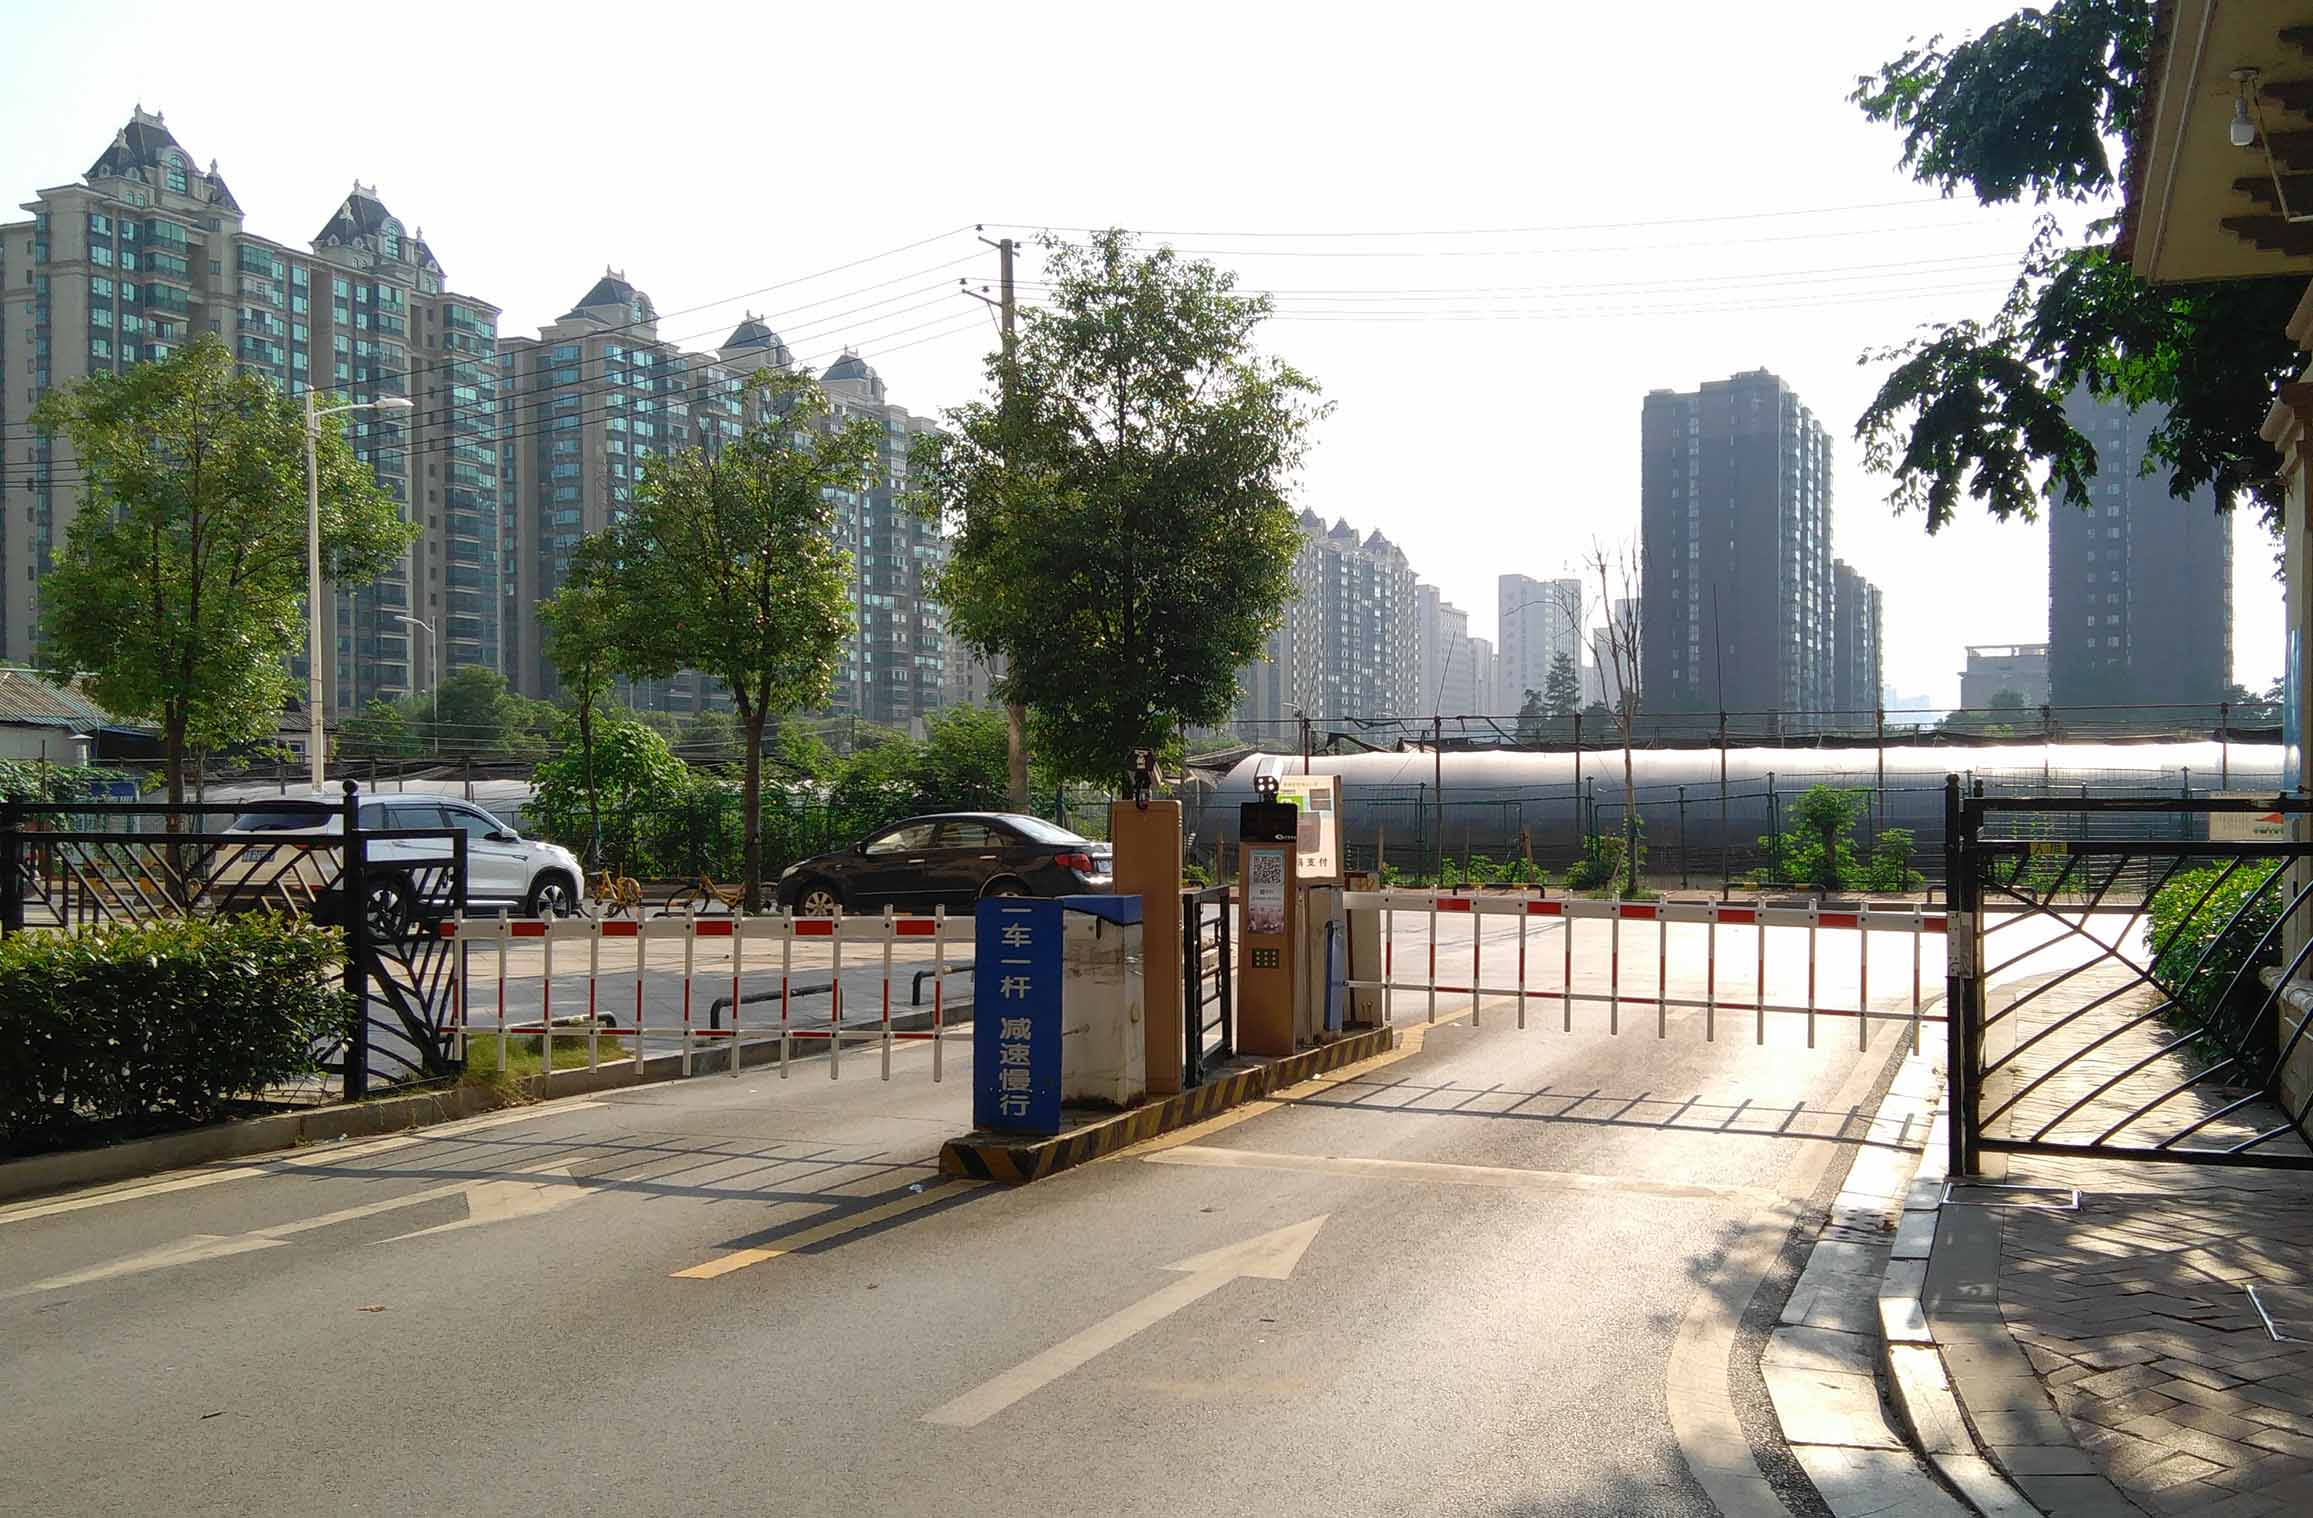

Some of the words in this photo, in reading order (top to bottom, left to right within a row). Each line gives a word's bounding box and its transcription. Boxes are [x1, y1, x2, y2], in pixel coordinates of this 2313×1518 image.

[1001, 907, 1033, 999] 一车一杆
[999, 1017, 1033, 1116] 减速慢行
